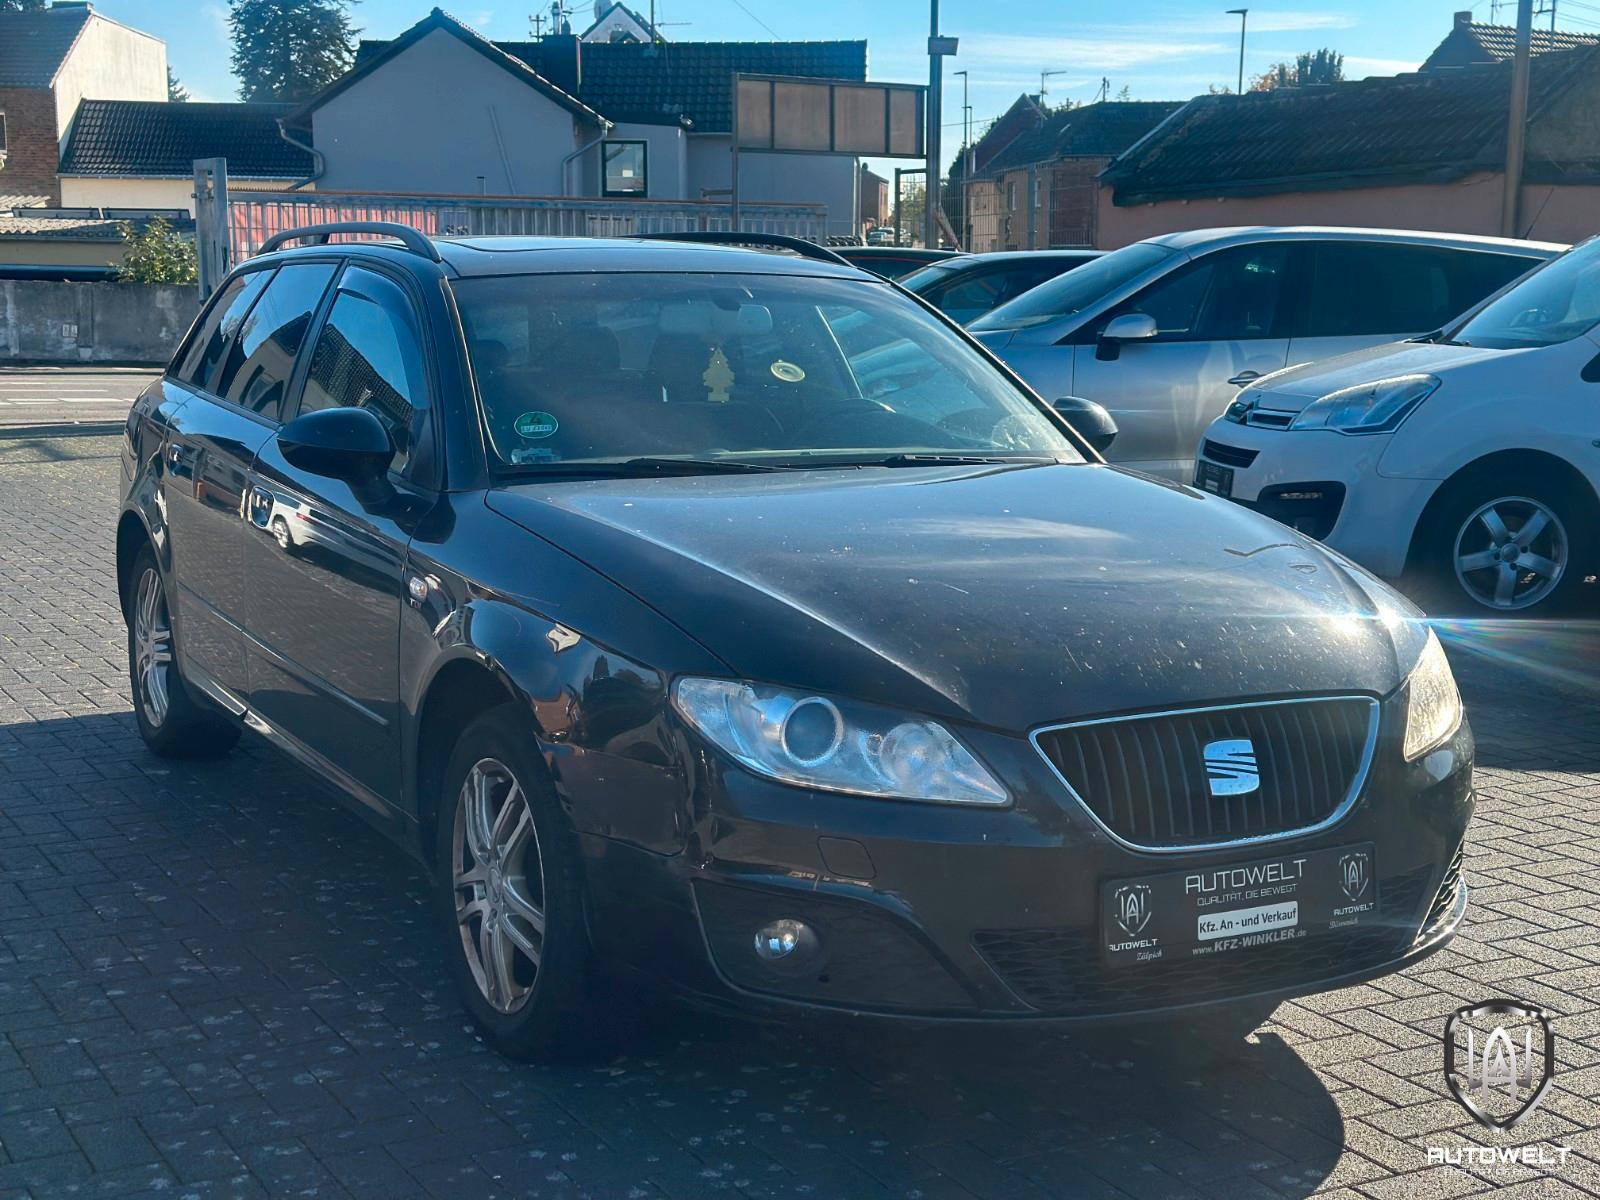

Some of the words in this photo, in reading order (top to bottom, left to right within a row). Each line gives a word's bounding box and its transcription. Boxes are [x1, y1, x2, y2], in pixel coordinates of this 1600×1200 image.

[1185, 859, 1307, 895] AUTOWELT
[1260, 883, 1298, 898] BEWEGT
[1333, 902, 1375, 916] AUTOWELT
[1199, 921, 1219, 934] Kfz.
[1220, 919, 1233, 931] An
[1241, 914, 1260, 927] und
[1261, 908, 1297, 924] Verkauf
[1108, 938, 1159, 952] AUTOWELT
